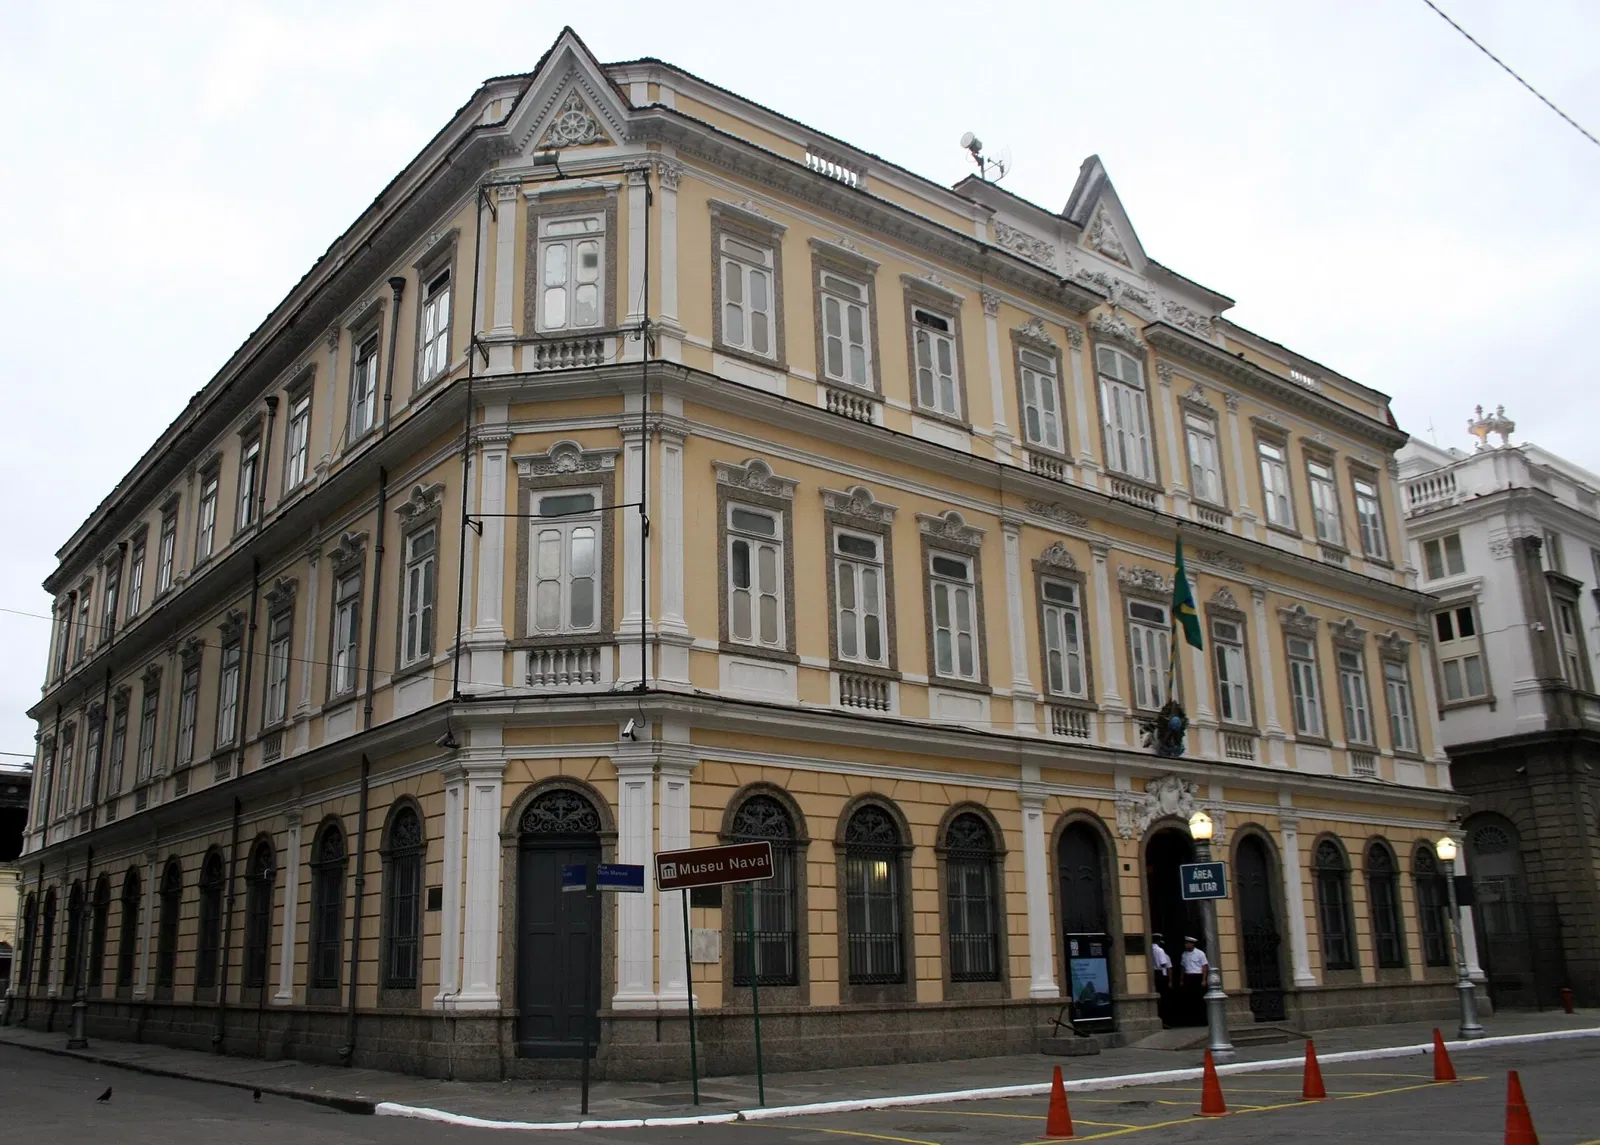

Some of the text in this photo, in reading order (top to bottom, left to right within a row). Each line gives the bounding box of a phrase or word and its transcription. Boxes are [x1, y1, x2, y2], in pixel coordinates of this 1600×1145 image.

[680, 854, 769, 876] Museu Naval
[1192, 867, 1213, 880] ÁREA
[1189, 882, 1218, 893] MILITAR
